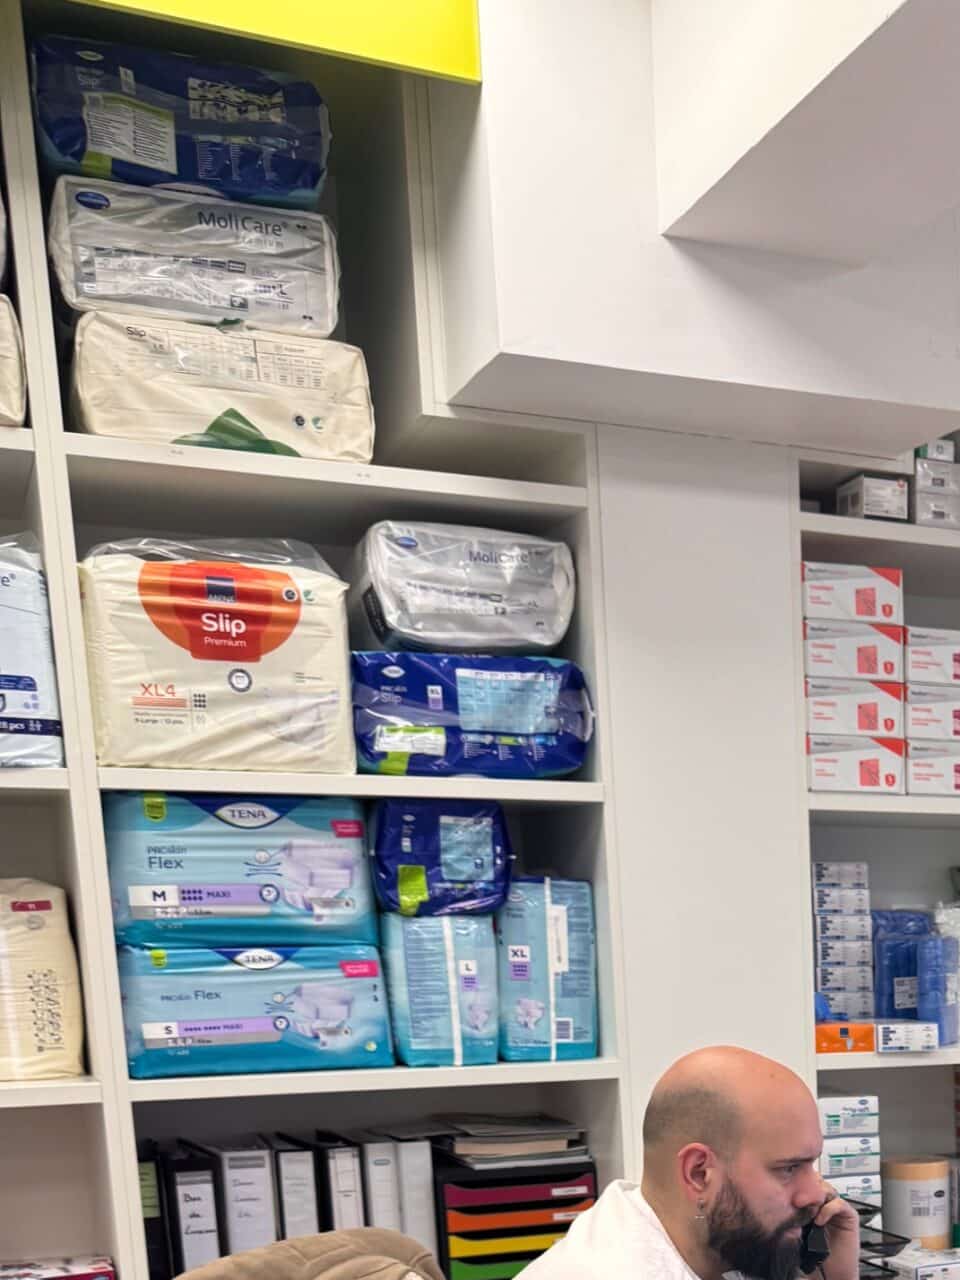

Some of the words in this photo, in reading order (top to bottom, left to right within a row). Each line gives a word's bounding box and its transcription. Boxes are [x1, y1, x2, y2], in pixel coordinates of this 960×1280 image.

[201, 612, 247, 638] Slip
[204, 636, 247, 648] Premium
[141, 683, 176, 697] XL4
[230, 808, 266, 820] TENA
[148, 856, 184, 869] Flex
[152, 890, 167, 902] M
[207, 891, 231, 899] MAXI
[244, 954, 276, 965] TENA
[511, 949, 527, 958] XL
[194, 990, 222, 1000] Flex
[164, 1026, 173, 1035] S
